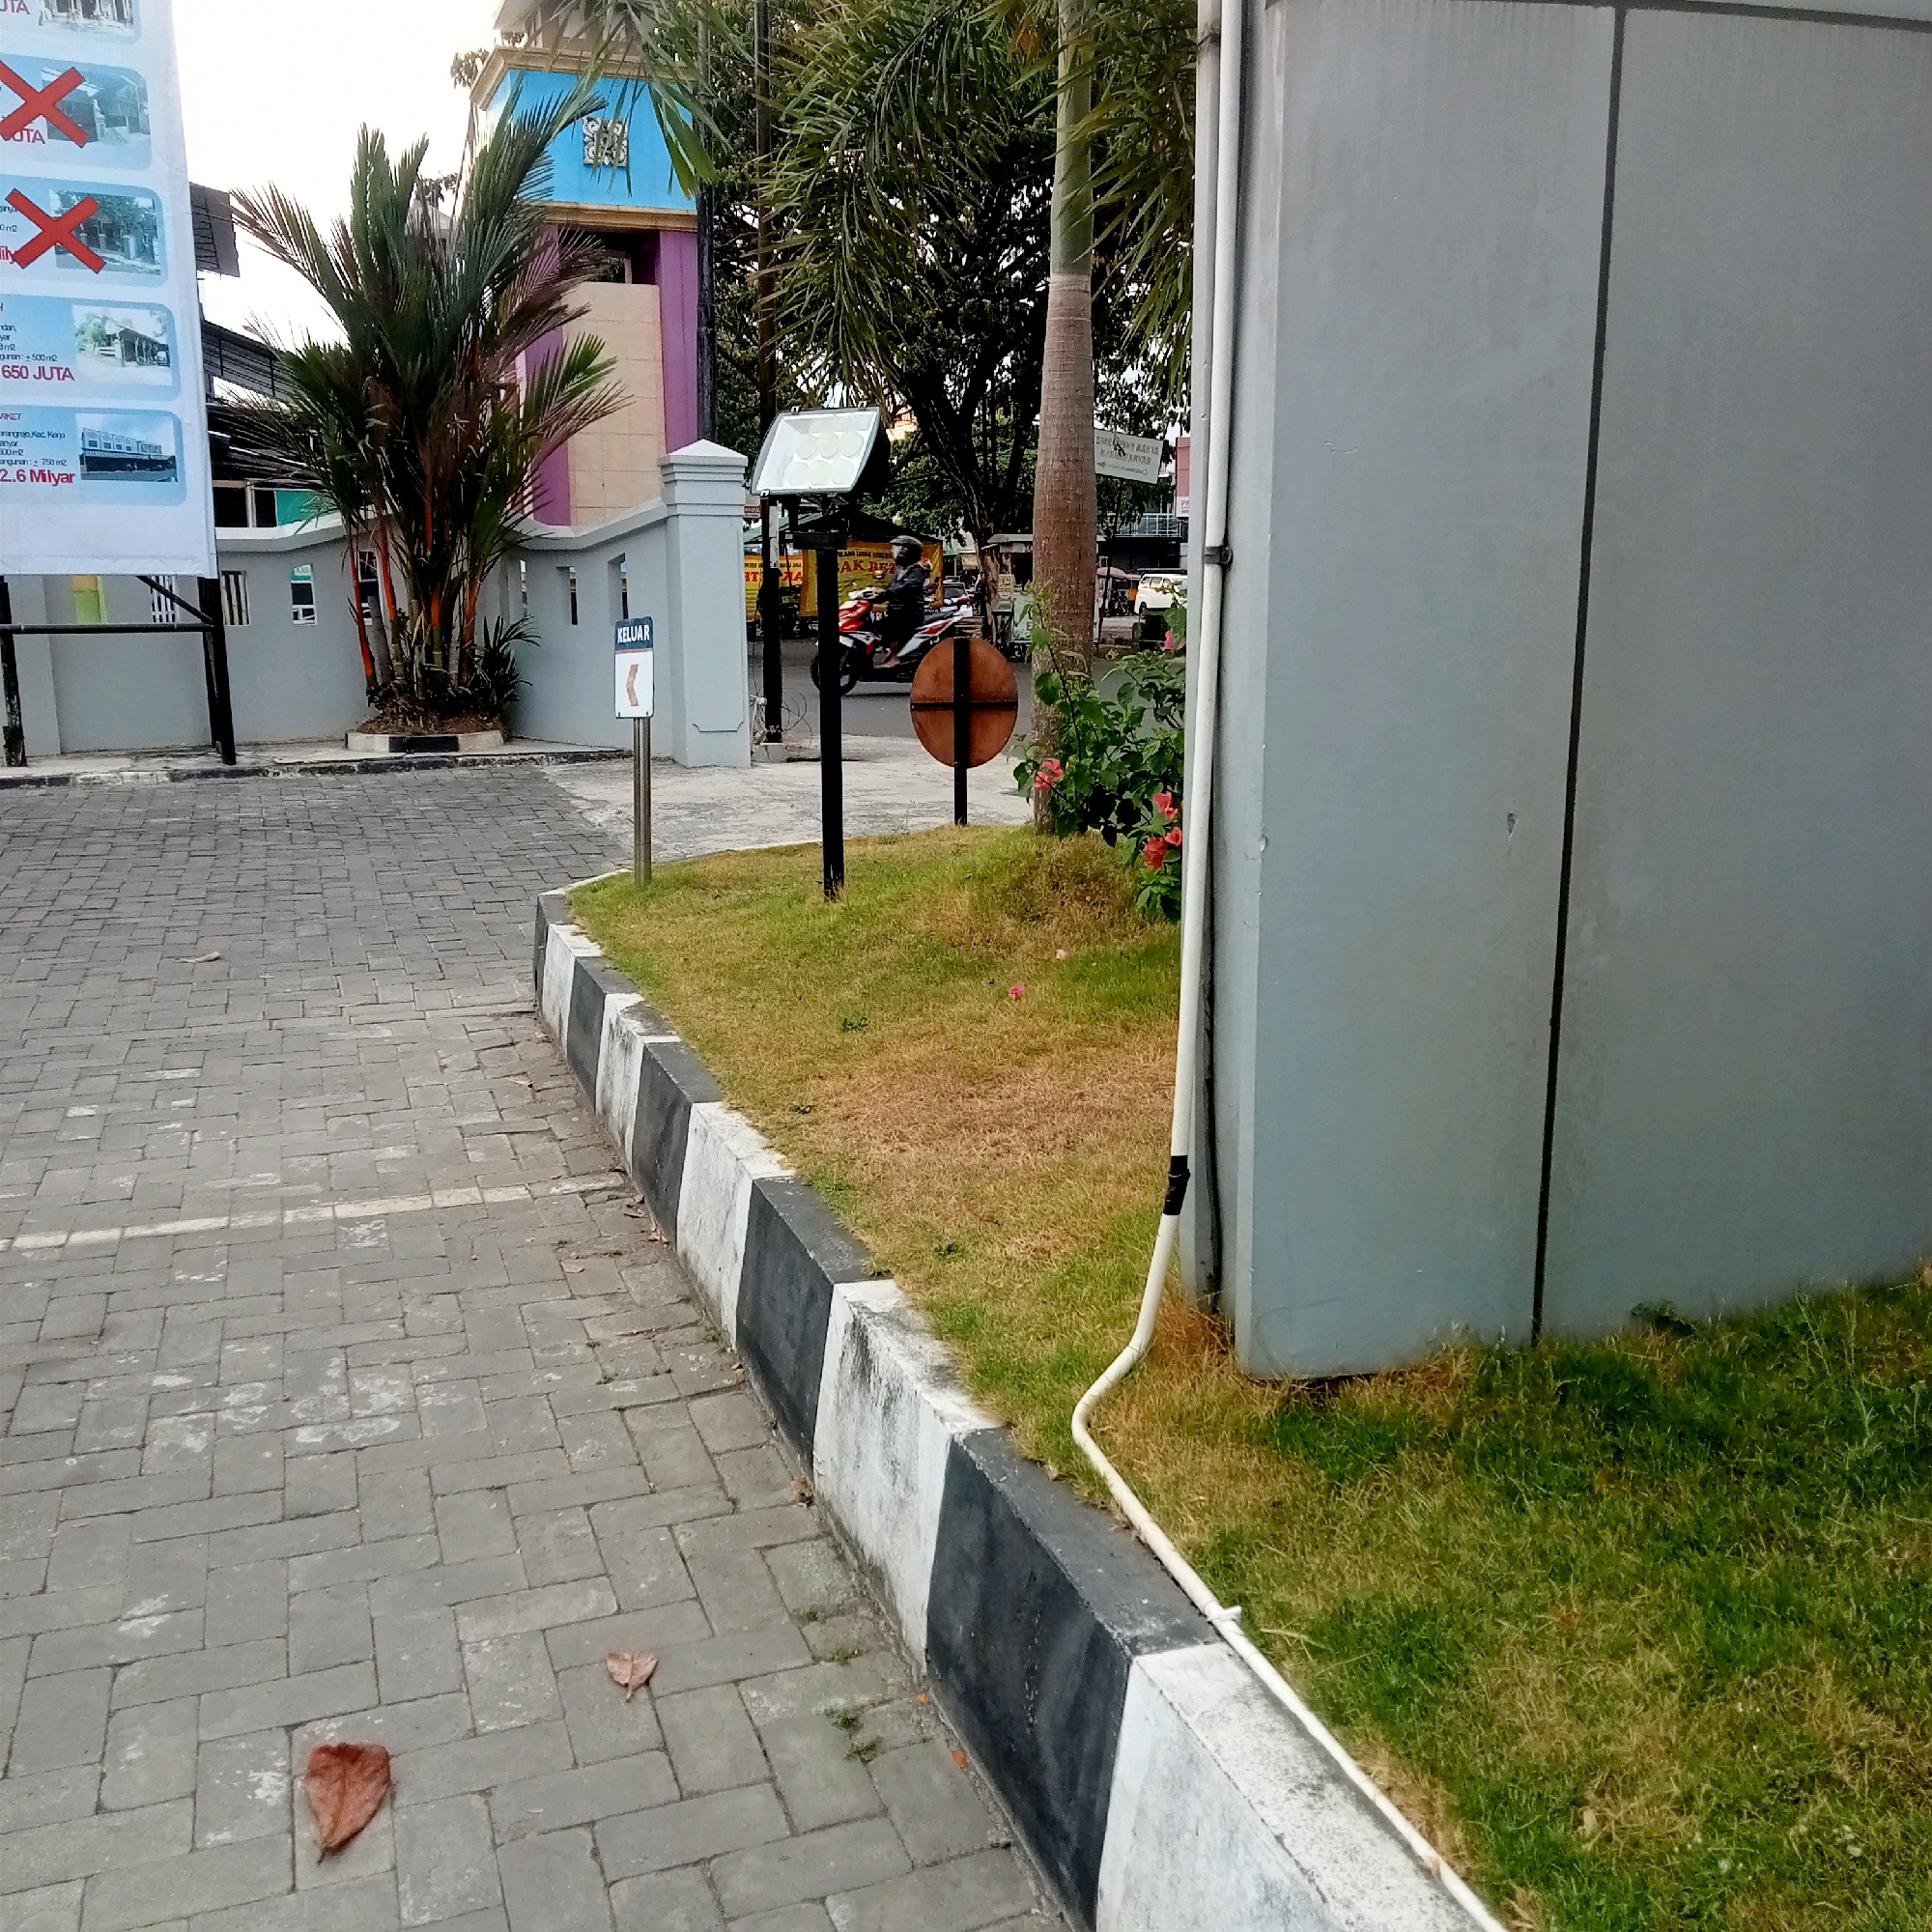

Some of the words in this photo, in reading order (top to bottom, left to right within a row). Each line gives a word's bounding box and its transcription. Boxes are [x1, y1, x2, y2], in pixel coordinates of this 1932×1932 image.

[2, 364, 29, 379] 650
[33, 365, 75, 382] JUTA
[29, 469, 76, 487] Milyar
[617, 624, 650, 643] KELUAR
